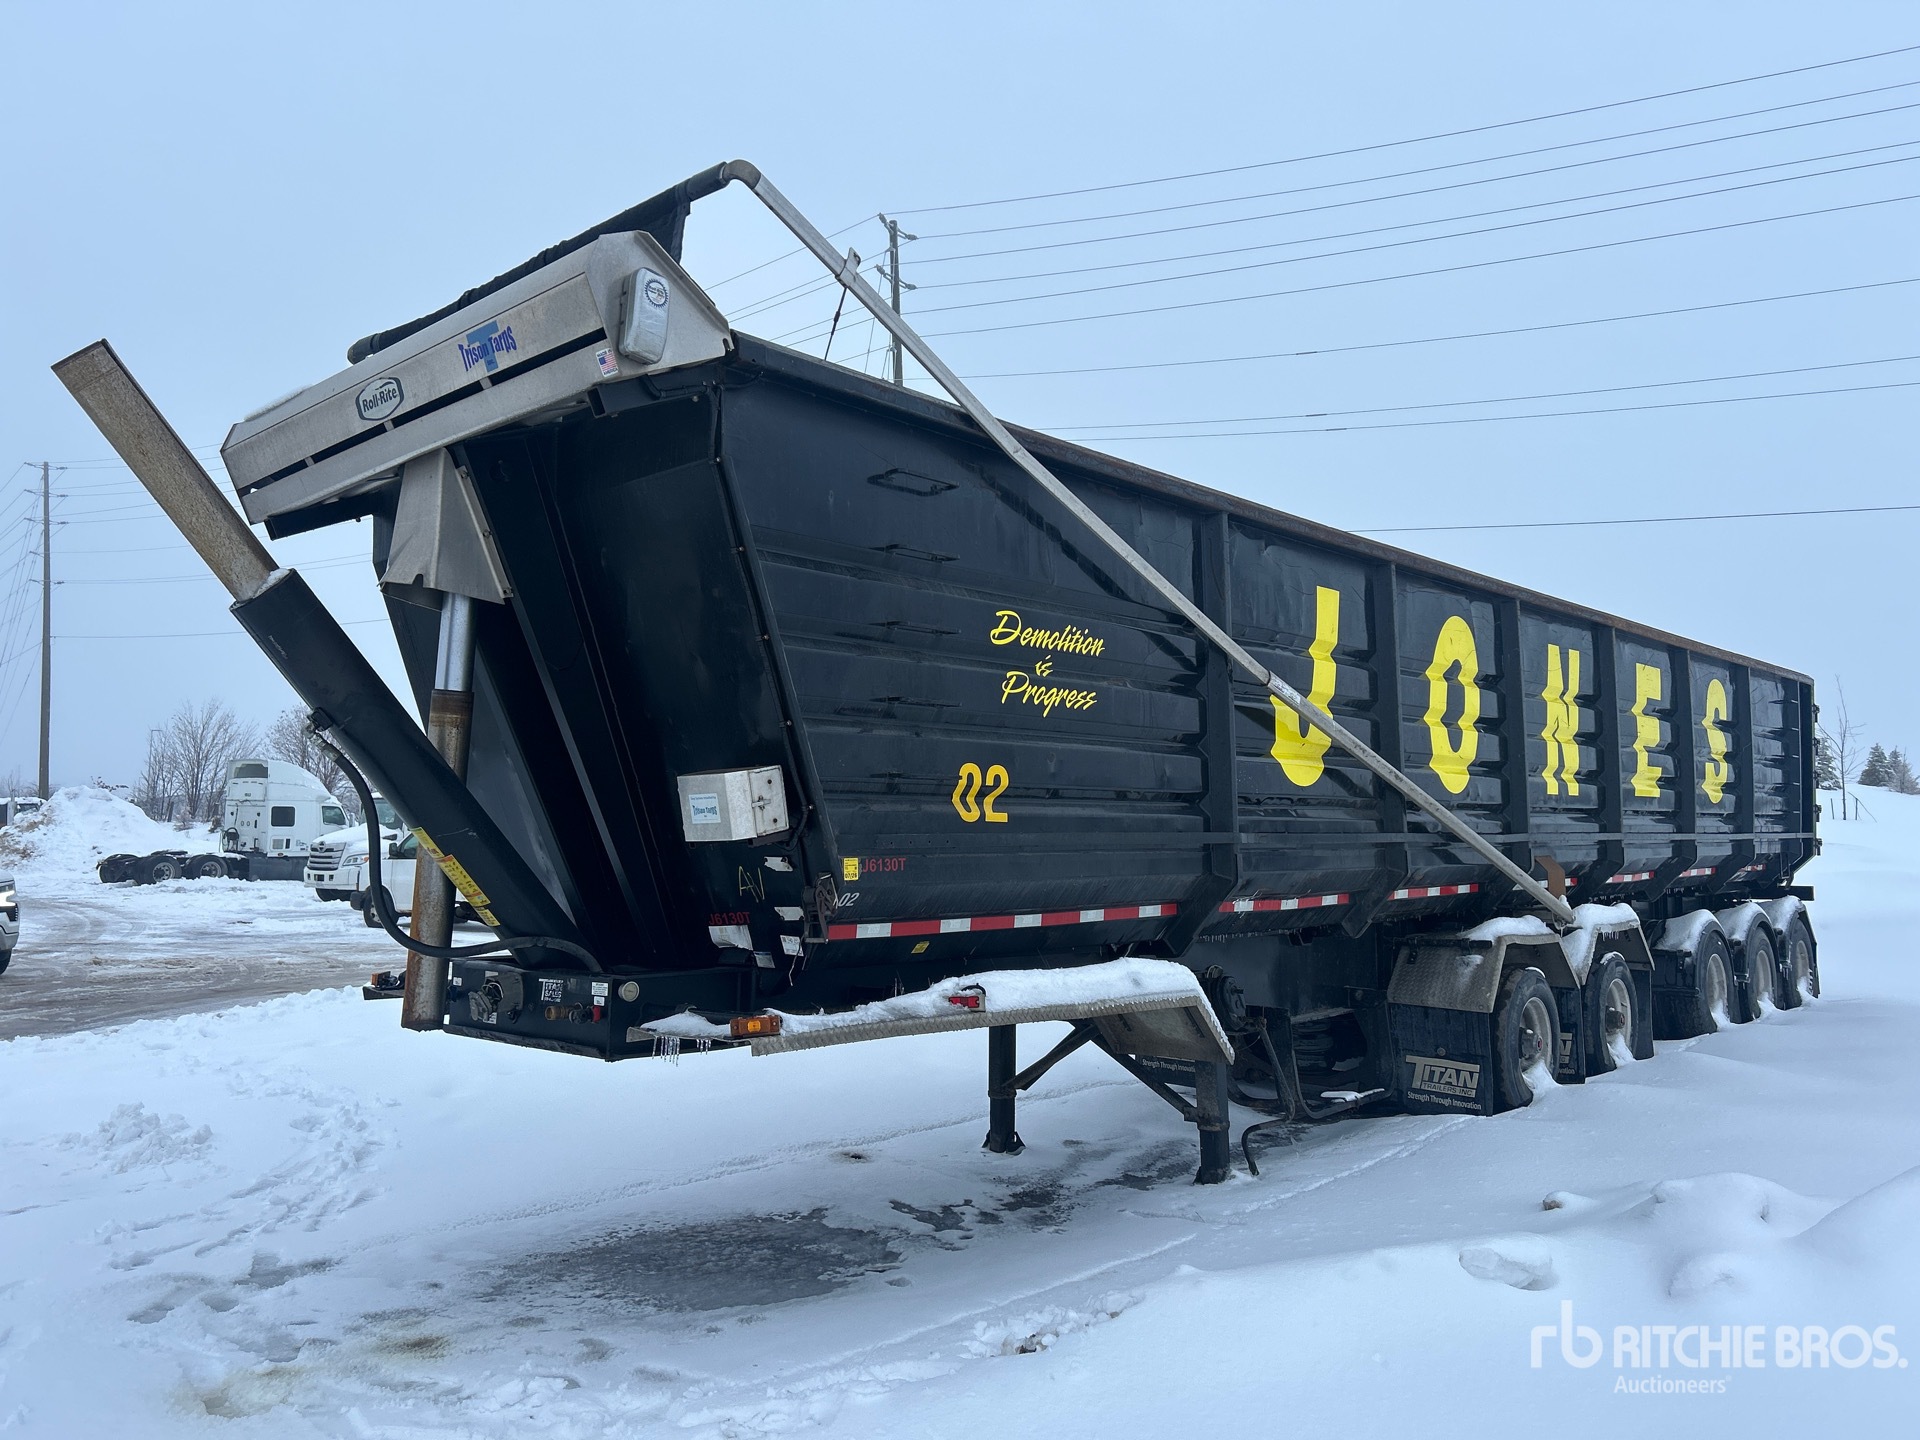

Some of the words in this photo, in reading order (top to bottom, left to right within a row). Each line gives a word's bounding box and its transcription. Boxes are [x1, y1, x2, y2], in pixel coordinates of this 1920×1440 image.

[458, 343, 490, 372] Trison
[488, 325, 517, 353] Tarps
[990, 610, 1105, 656] Demolition
[1035, 654, 1054, 677] is
[1002, 671, 1097, 717] Progress
[1270, 585, 1727, 804] JONES
[952, 762, 1009, 823] 02
[863, 857, 907, 872] J6130T
[708, 911, 751, 925] J6130T
[1405, 1054, 1480, 1089] TITAN
[1423, 1082, 1457, 1094] TRAILERS
[1407, 1091, 1430, 1103] Strength
[1430, 1094, 1452, 1107] Through
[1452, 1098, 1482, 1110] Innovation
